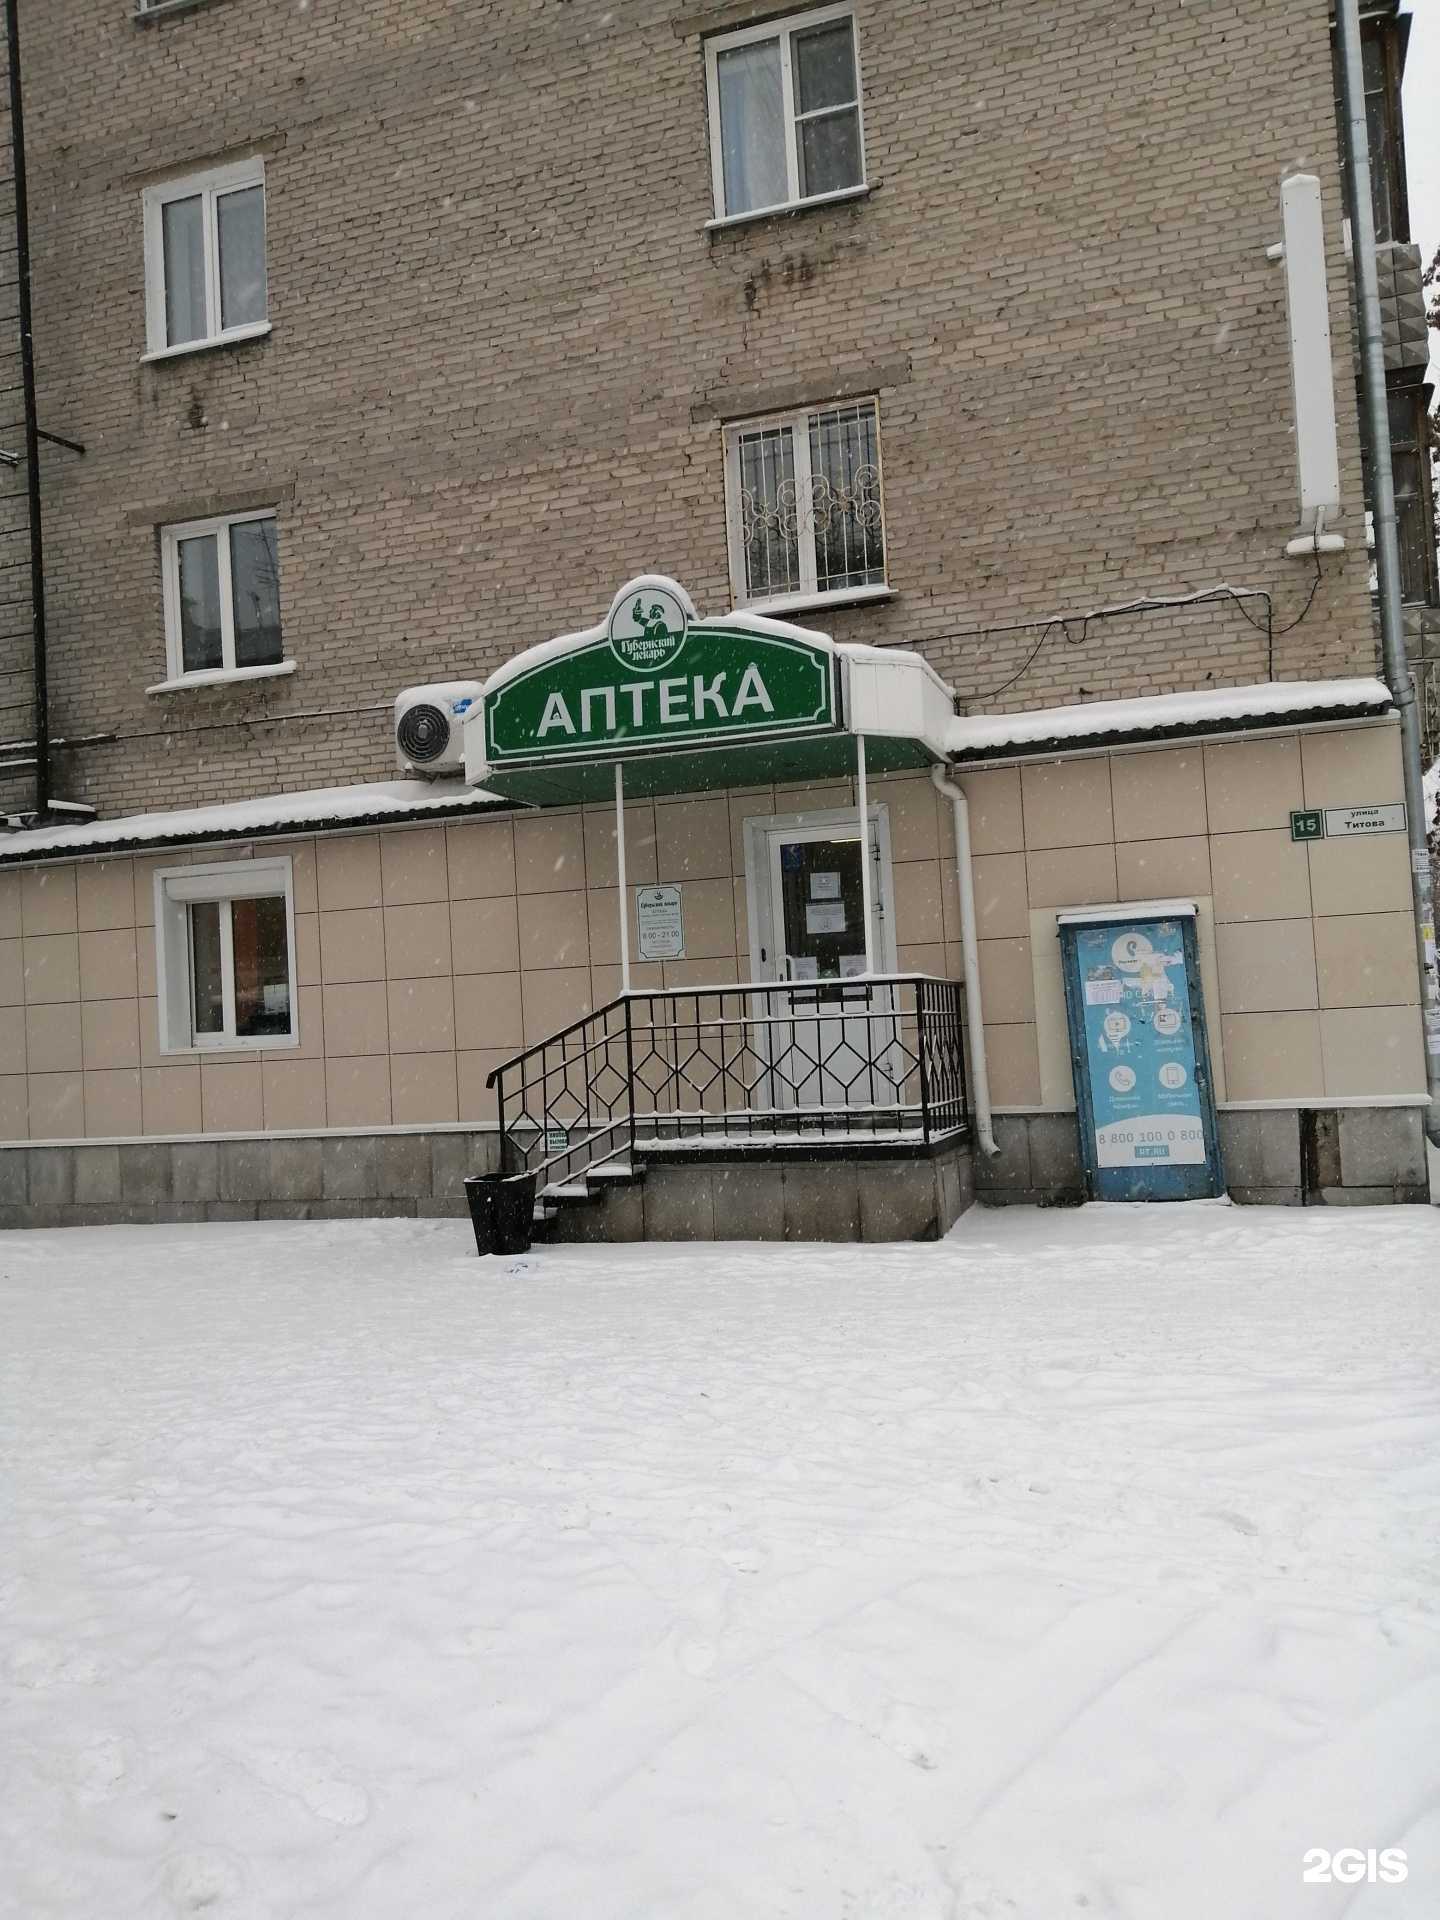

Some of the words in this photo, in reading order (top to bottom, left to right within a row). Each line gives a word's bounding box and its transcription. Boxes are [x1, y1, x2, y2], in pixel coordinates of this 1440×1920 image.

[621, 635, 675, 655] Губернский
[632, 648, 665, 661] лекарь
[536, 662, 775, 738] АПТЕКА
[1351, 809, 1379, 818] улица
[1296, 819, 1317, 832] 15
[1344, 820, 1385, 829] Титова
[1098, 1133, 1106, 1144] 8
[1111, 1132, 1134, 1143] 800
[1138, 1130, 1162, 1142] 100
[1167, 1130, 1176, 1140] 0
